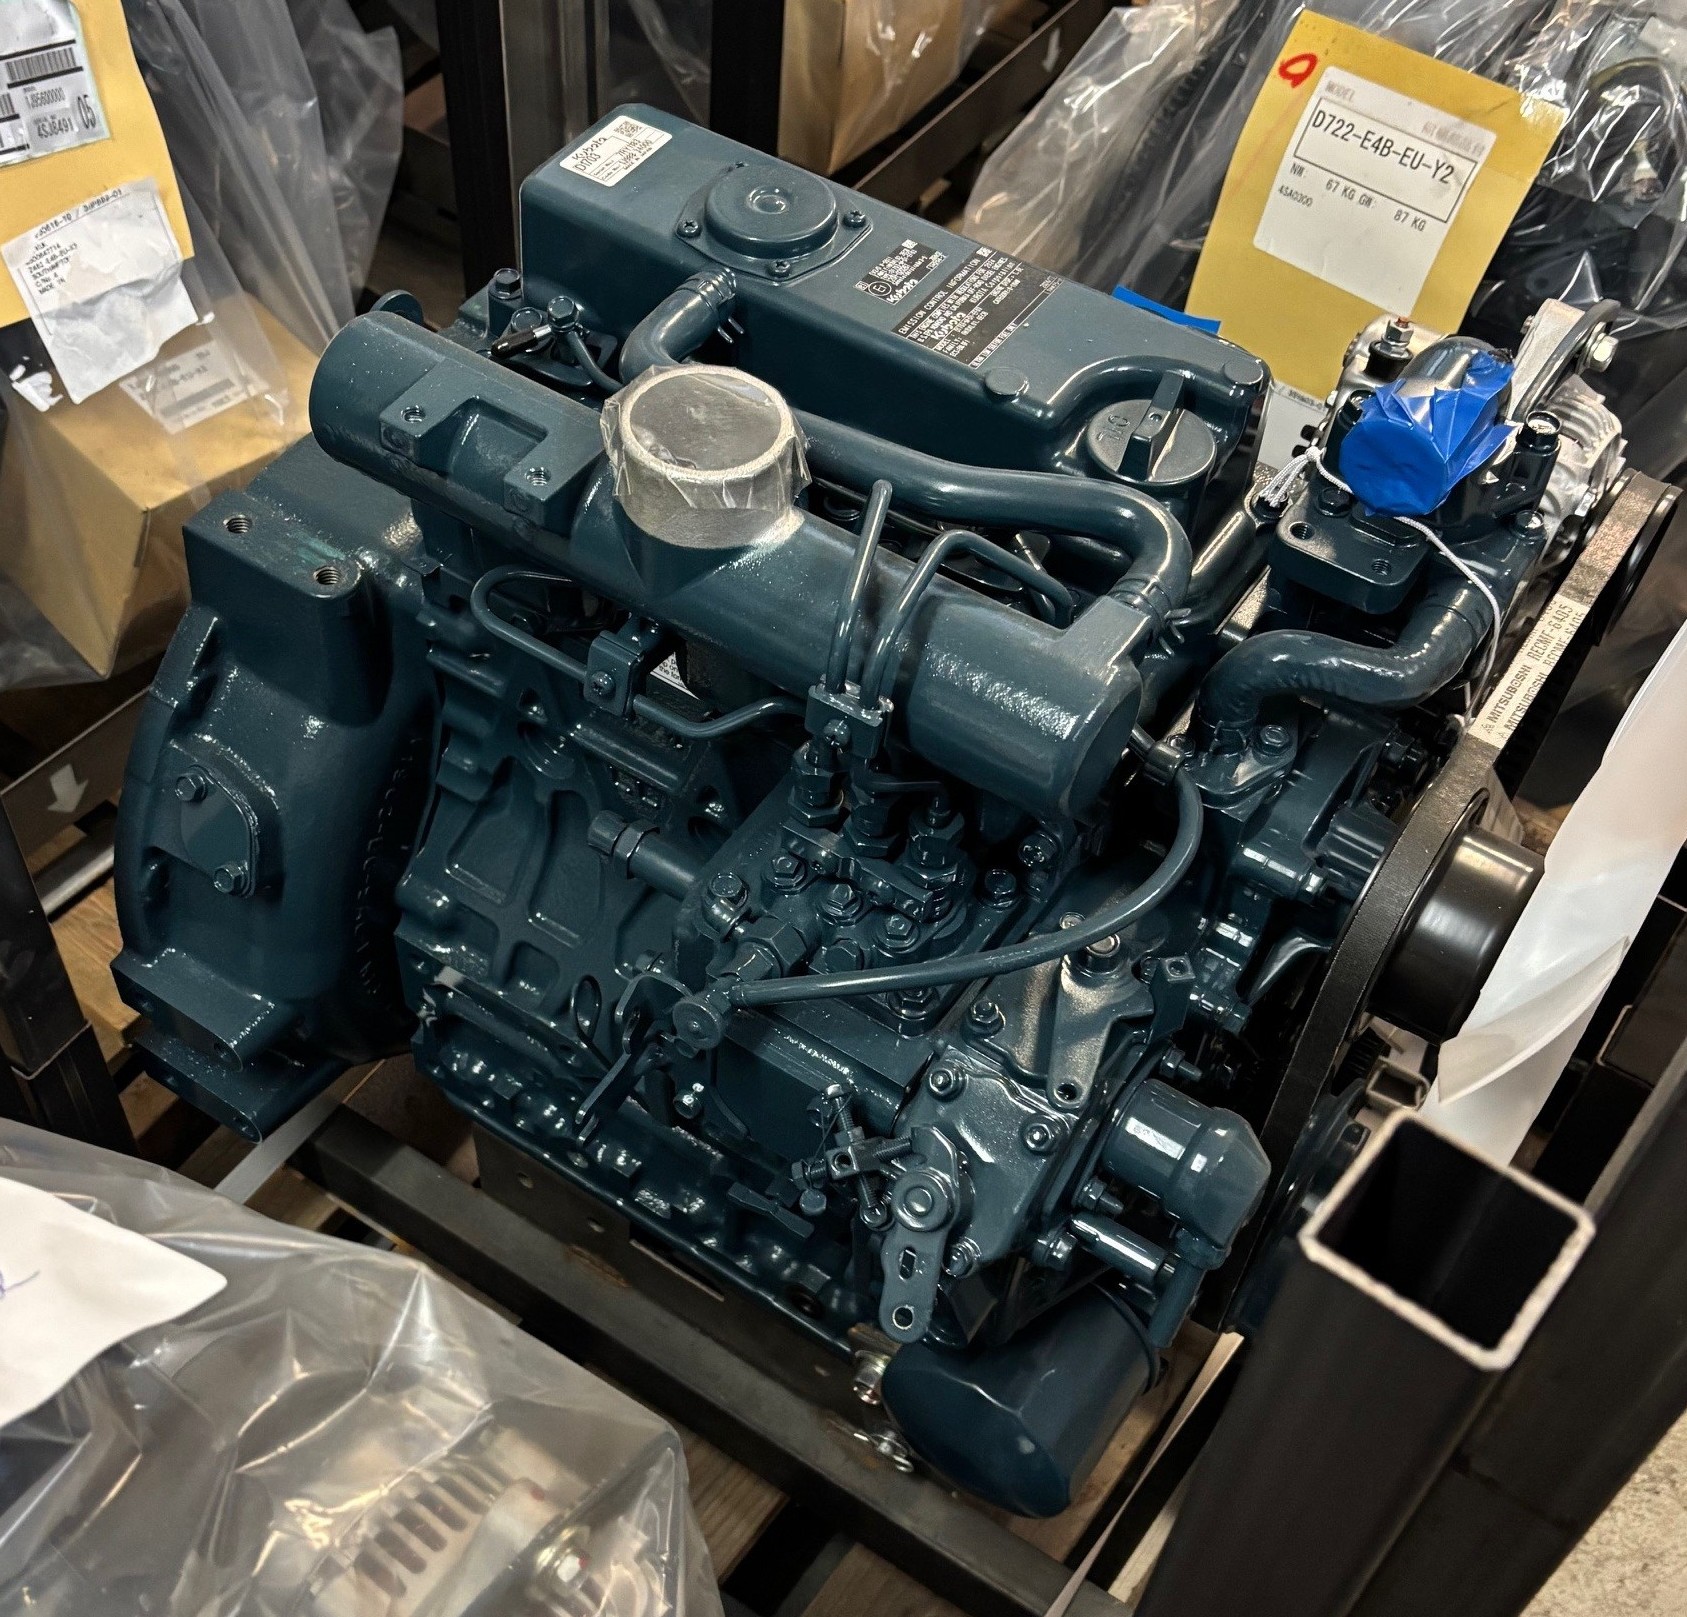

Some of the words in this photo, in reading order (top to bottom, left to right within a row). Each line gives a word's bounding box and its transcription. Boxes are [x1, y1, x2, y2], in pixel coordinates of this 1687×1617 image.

[77, 94, 96, 129] 05
[570, 135, 607, 161] Kubota
[573, 152, 602, 171] D1703
[1312, 110, 1455, 184] D722-E4B-EU-Y2
[1326, 179, 1340, 192] 67
[1342, 186, 1356, 200] KG
[1394, 210, 1409, 223] 87
[1411, 217, 1426, 232] KG
[885, 277, 918, 303] Kubota
[897, 309, 927, 334] EMISSION
[922, 289, 948, 310] CONTROL
[944, 258, 981, 288] INFORMATION
[929, 310, 966, 340] Kubota
[1487, 665, 1532, 724] MITSUBOSHI
